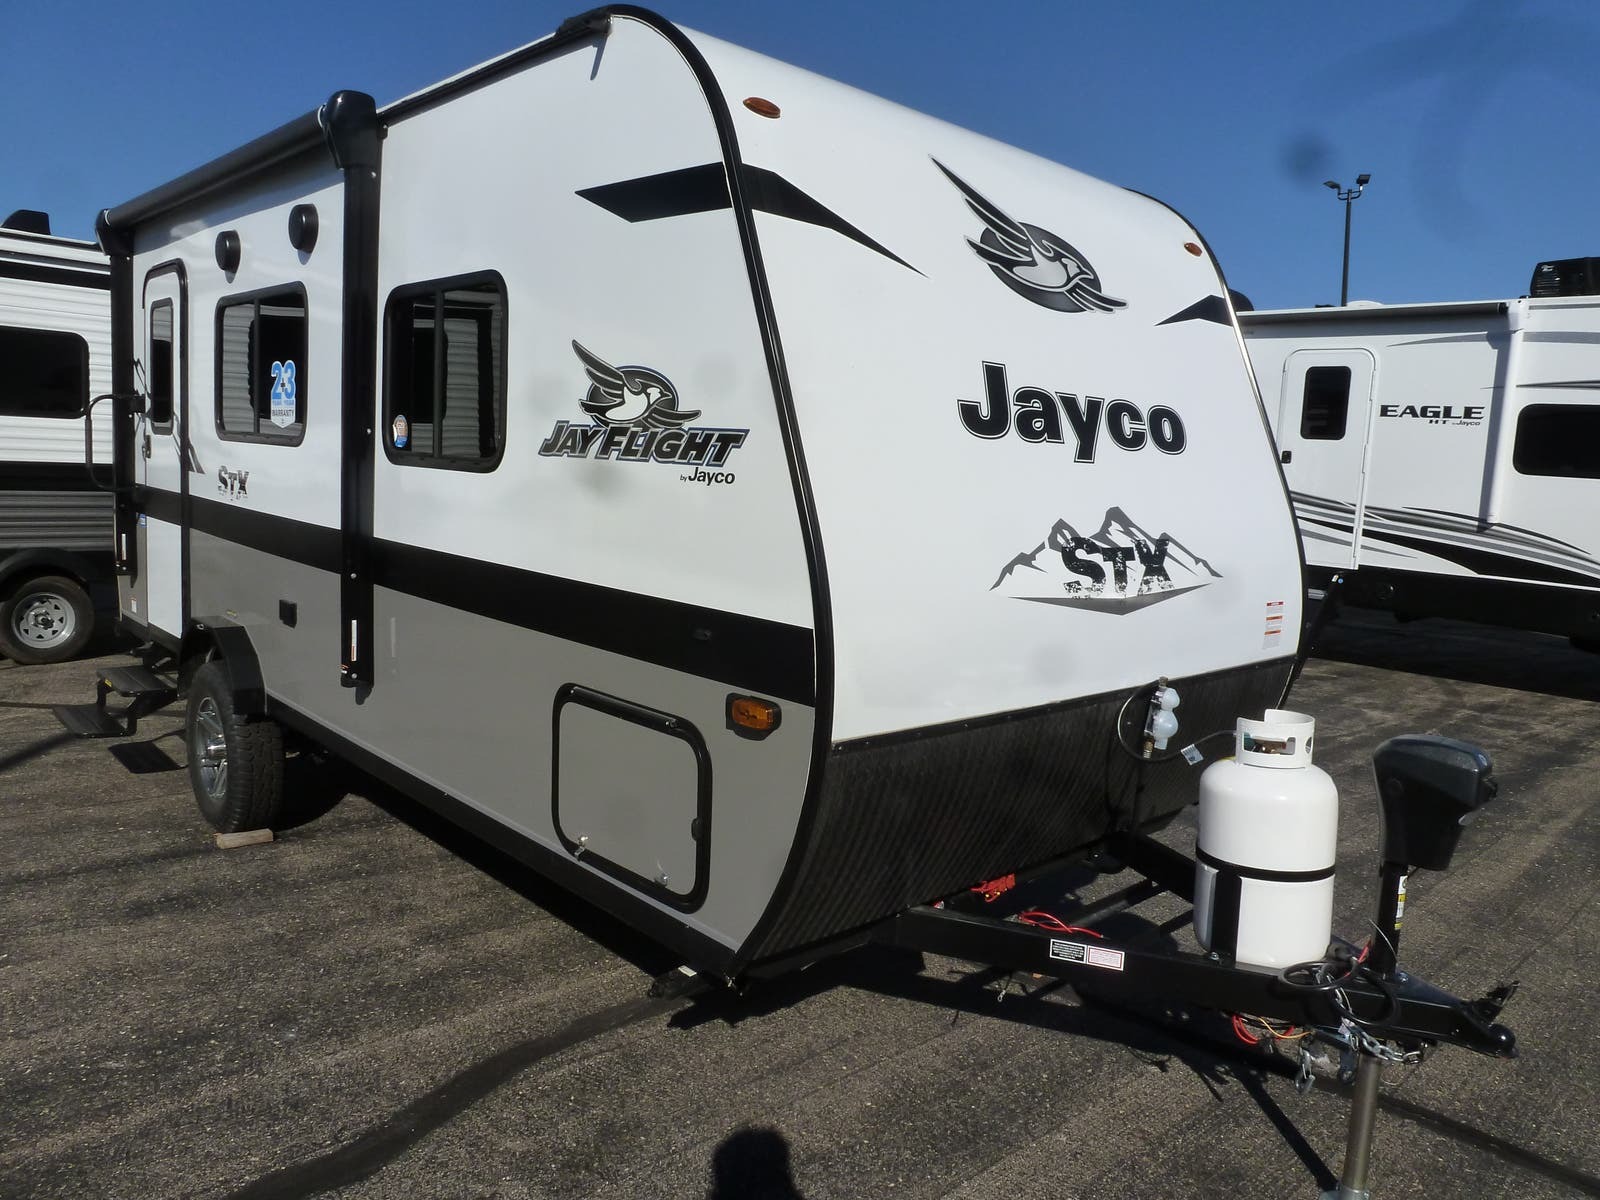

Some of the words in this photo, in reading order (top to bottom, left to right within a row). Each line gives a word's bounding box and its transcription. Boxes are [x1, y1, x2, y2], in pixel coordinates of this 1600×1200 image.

[957, 360, 1187, 464] Jayco
[1380, 404, 1486, 420] EAGLE
[538, 420, 602, 459] JAY
[595, 423, 750, 467] FLIGHT
[218, 465, 249, 499] STX
[680, 474, 687, 482] by
[688, 466, 735, 486] Jayco
[1061, 537, 1175, 600] STX
